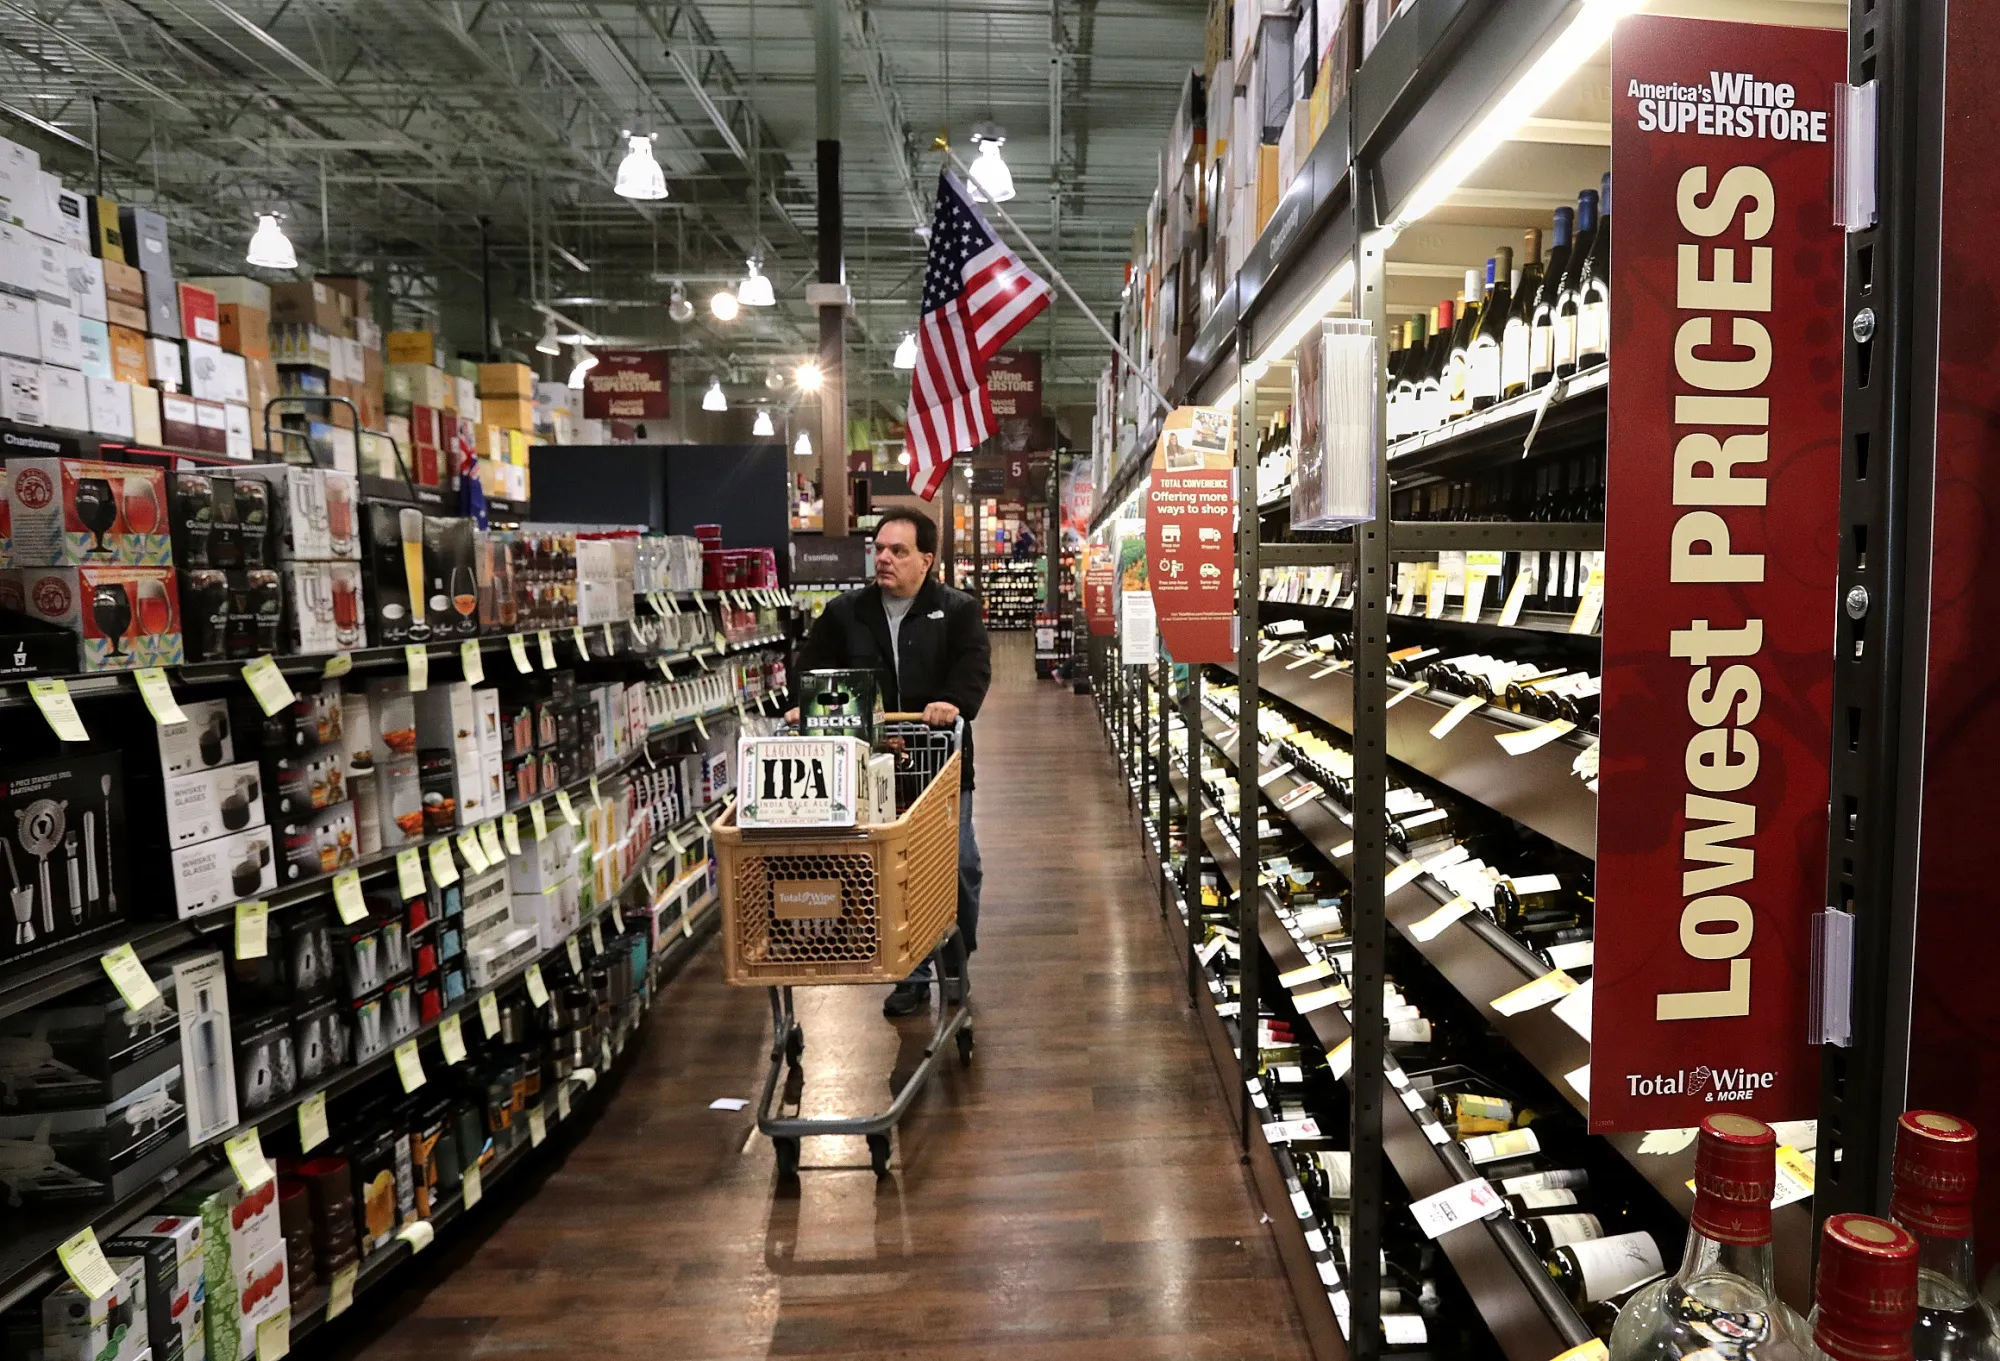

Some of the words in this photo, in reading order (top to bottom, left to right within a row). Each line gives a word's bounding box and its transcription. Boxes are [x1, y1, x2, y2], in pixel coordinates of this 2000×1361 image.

[1628, 78, 1712, 103] America's
[1710, 71, 1795, 109] Wine
[1638, 98, 1827, 143] SUPERSTORE
[991, 370, 1022, 381] Wine
[1669, 164, 1776, 584] PRICES
[592, 379, 662, 393] SUPERSTORE
[987, 380, 1034, 392] ERSTORE
[4, 432, 61, 453] Chardonnay
[1011, 461, 1022, 477] 5
[1160, 479, 1182, 489] TOTAL
[1182, 479, 1228, 489] CONVENIENCE
[1151, 491, 1197, 504] Offering
[1199, 493, 1228, 502] more
[1157, 505, 1185, 517] ways
[1187, 504, 1199, 514] to
[1201, 503, 1229, 516] shop
[803, 553, 839, 562] Essentials
[806, 715, 862, 728] BECK'S
[764, 744, 826, 758] LAGUNITAS
[761, 758, 829, 800] IPA
[173, 783, 208, 798] WHISKEY
[175, 793, 208, 807] GLASSES
[760, 801, 783, 809] INDIA
[787, 800, 809, 809] PALE
[813, 800, 829, 808] ALE
[1656, 618, 1764, 1022] Lowest
[181, 853, 217, 869] WHISKEY
[182, 862, 217, 878] GLASSES
[1626, 1070, 1685, 1096] Total
[1711, 1067, 1775, 1092] Wine
[1704, 1092, 1715, 1103] &
[1717, 1089, 1754, 1102] MORE
